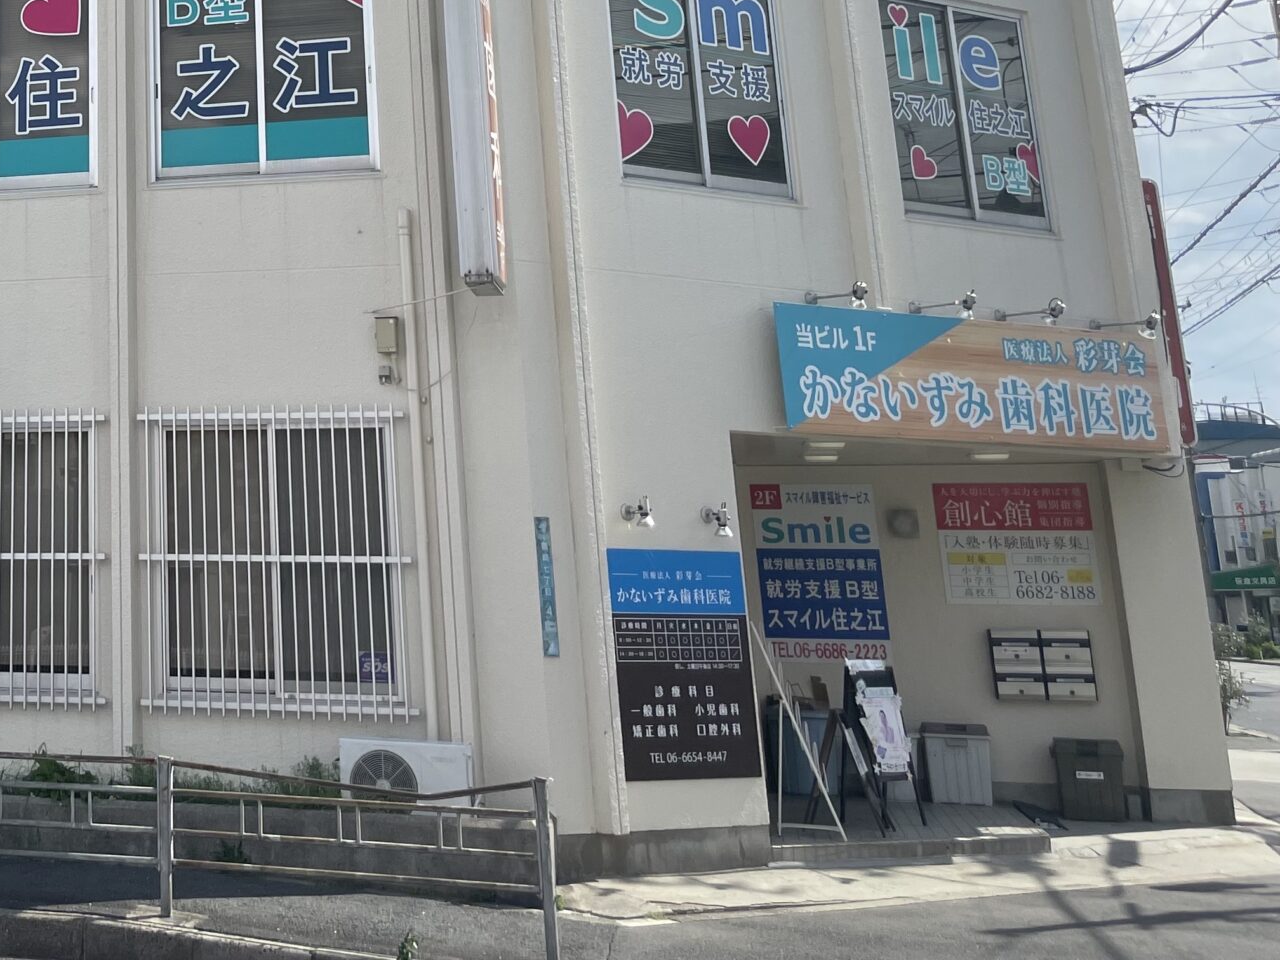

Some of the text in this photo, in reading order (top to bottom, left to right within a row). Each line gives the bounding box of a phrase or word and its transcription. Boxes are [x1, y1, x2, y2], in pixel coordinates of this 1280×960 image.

[981, 154, 1032, 197] B型
[753, 490, 778, 506] 2F
[943, 499, 1032, 528] 創心館
[761, 516, 872, 544] Smile
[617, 587, 732, 605] かないずみ歯科医院
[1016, 585, 1096, 600] 6682-8188
[768, 607, 885, 631] スマイル住之江
[630, 703, 740, 717] 一般歯科 小児歯科
[696, 723, 741, 737] 口腔外科
